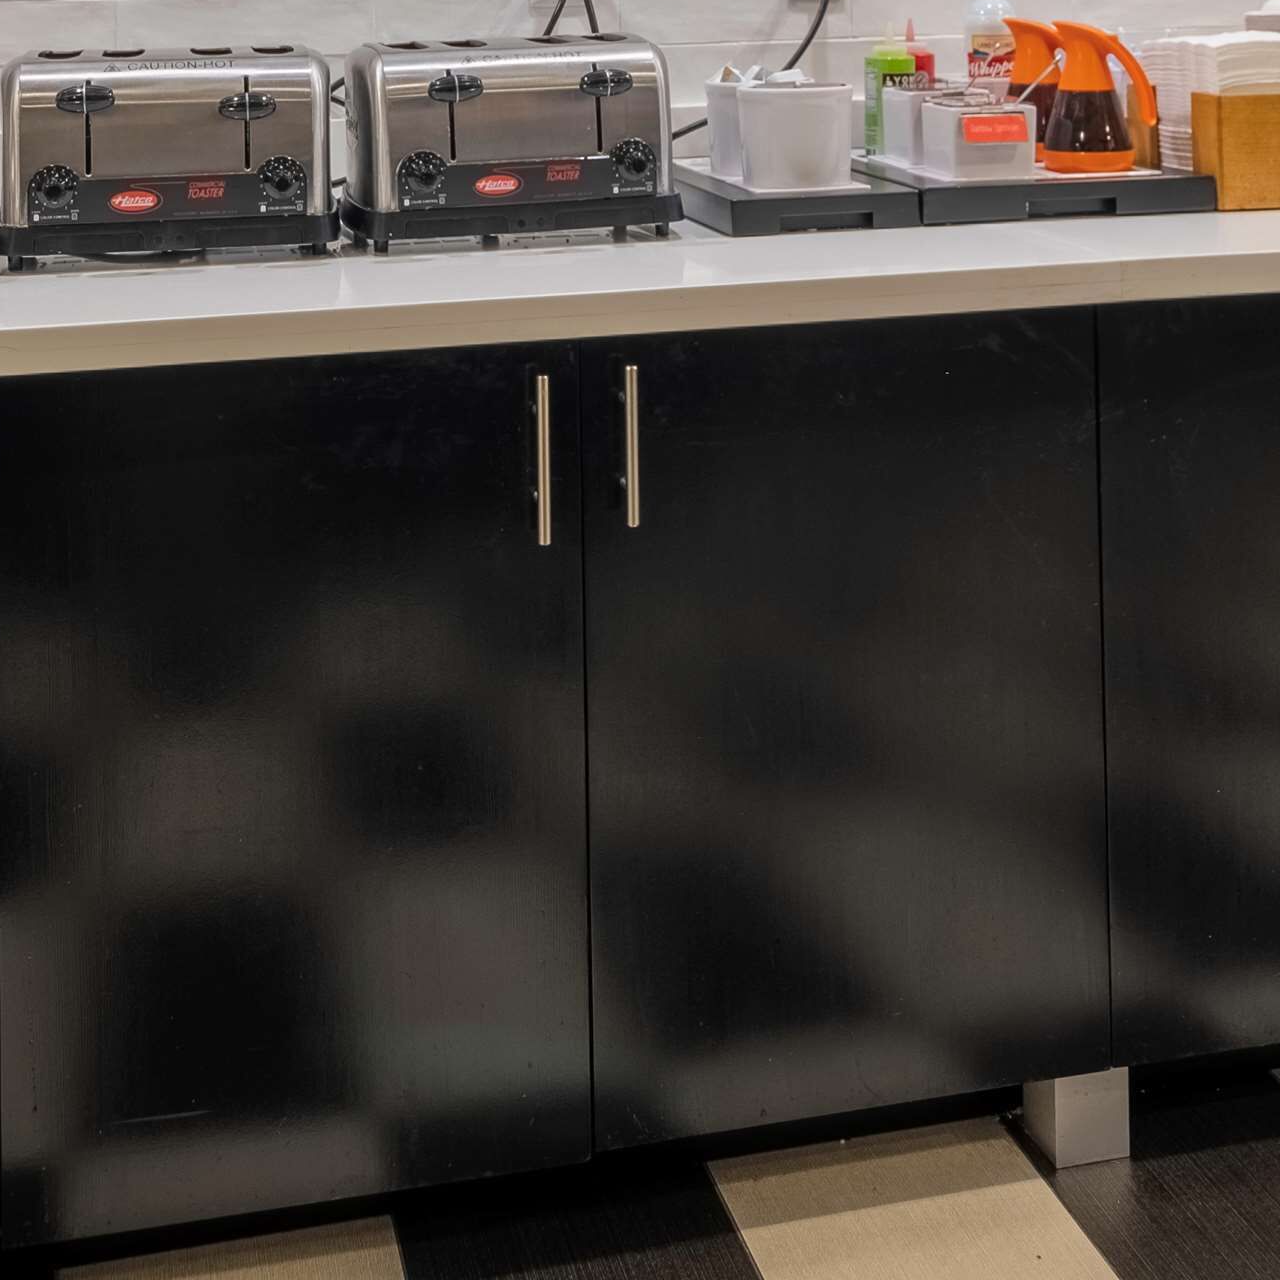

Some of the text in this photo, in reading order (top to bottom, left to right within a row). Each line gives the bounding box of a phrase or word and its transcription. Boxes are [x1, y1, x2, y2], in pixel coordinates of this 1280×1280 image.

[127, 60, 235, 71] CAUTION-HOT
[969, 60, 1014, 78] Whippe
[187, 188, 225, 200] TOASTER
[111, 195, 154, 208] Hatco
